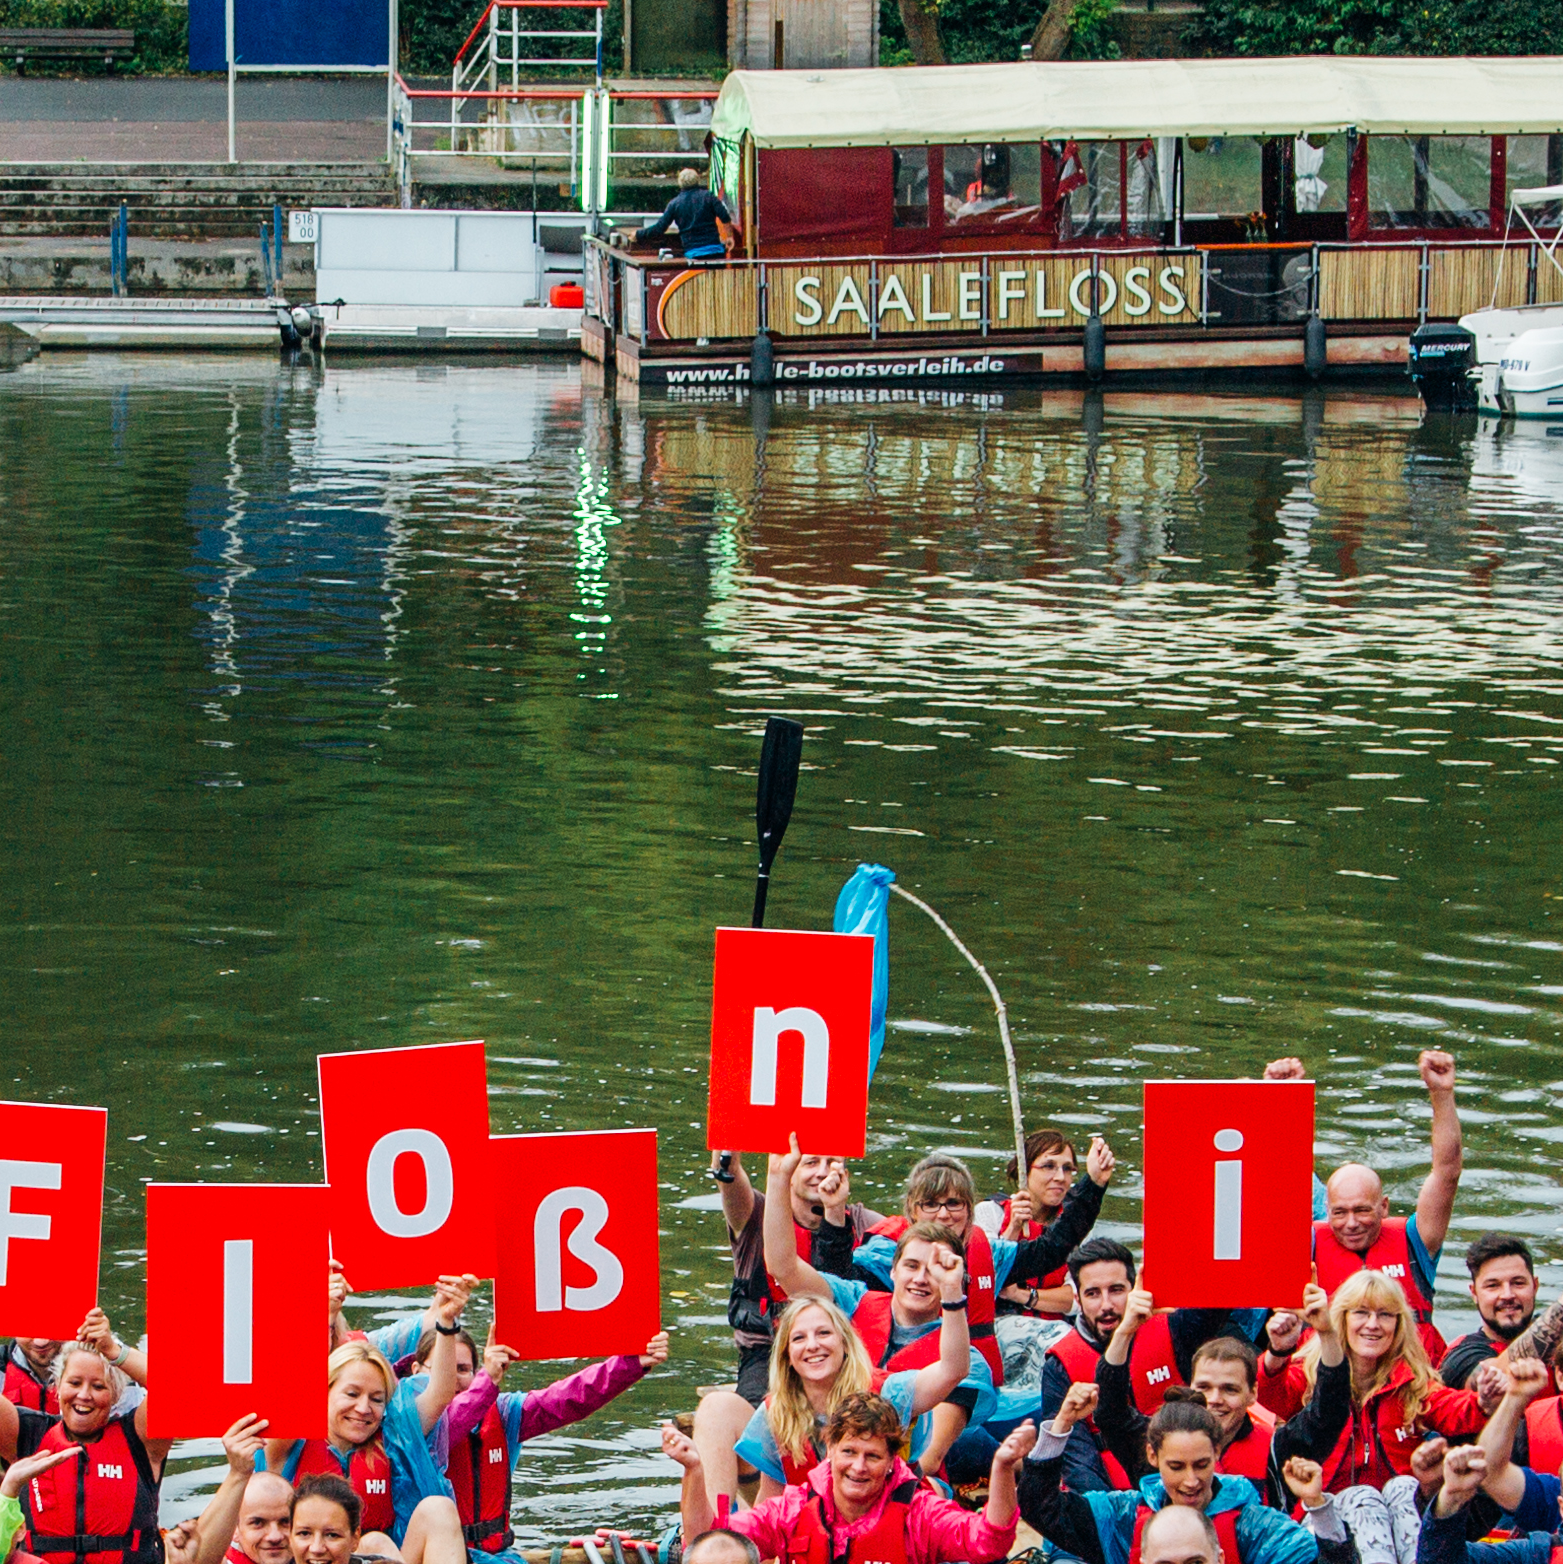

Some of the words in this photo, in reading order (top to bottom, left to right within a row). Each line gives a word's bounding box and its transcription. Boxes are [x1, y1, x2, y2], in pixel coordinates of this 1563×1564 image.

[294, 213, 314, 225] 518
[300, 227, 314, 238] 00
[794, 266, 1186, 327] SAALEFLOSS
[1420, 342, 1471, 352] MERCURY
[666, 356, 1005, 383] www.hle-bootsverleih.de
[750, 1007, 829, 1108] n
[1213, 1128, 1244, 1260] i
[978, 1275, 992, 1290] HH
[1147, 1365, 1171, 1385] HH
[489, 1447, 503, 1464] HH
[98, 1463, 123, 1479] HH
[365, 1479, 386, 1494] HH
